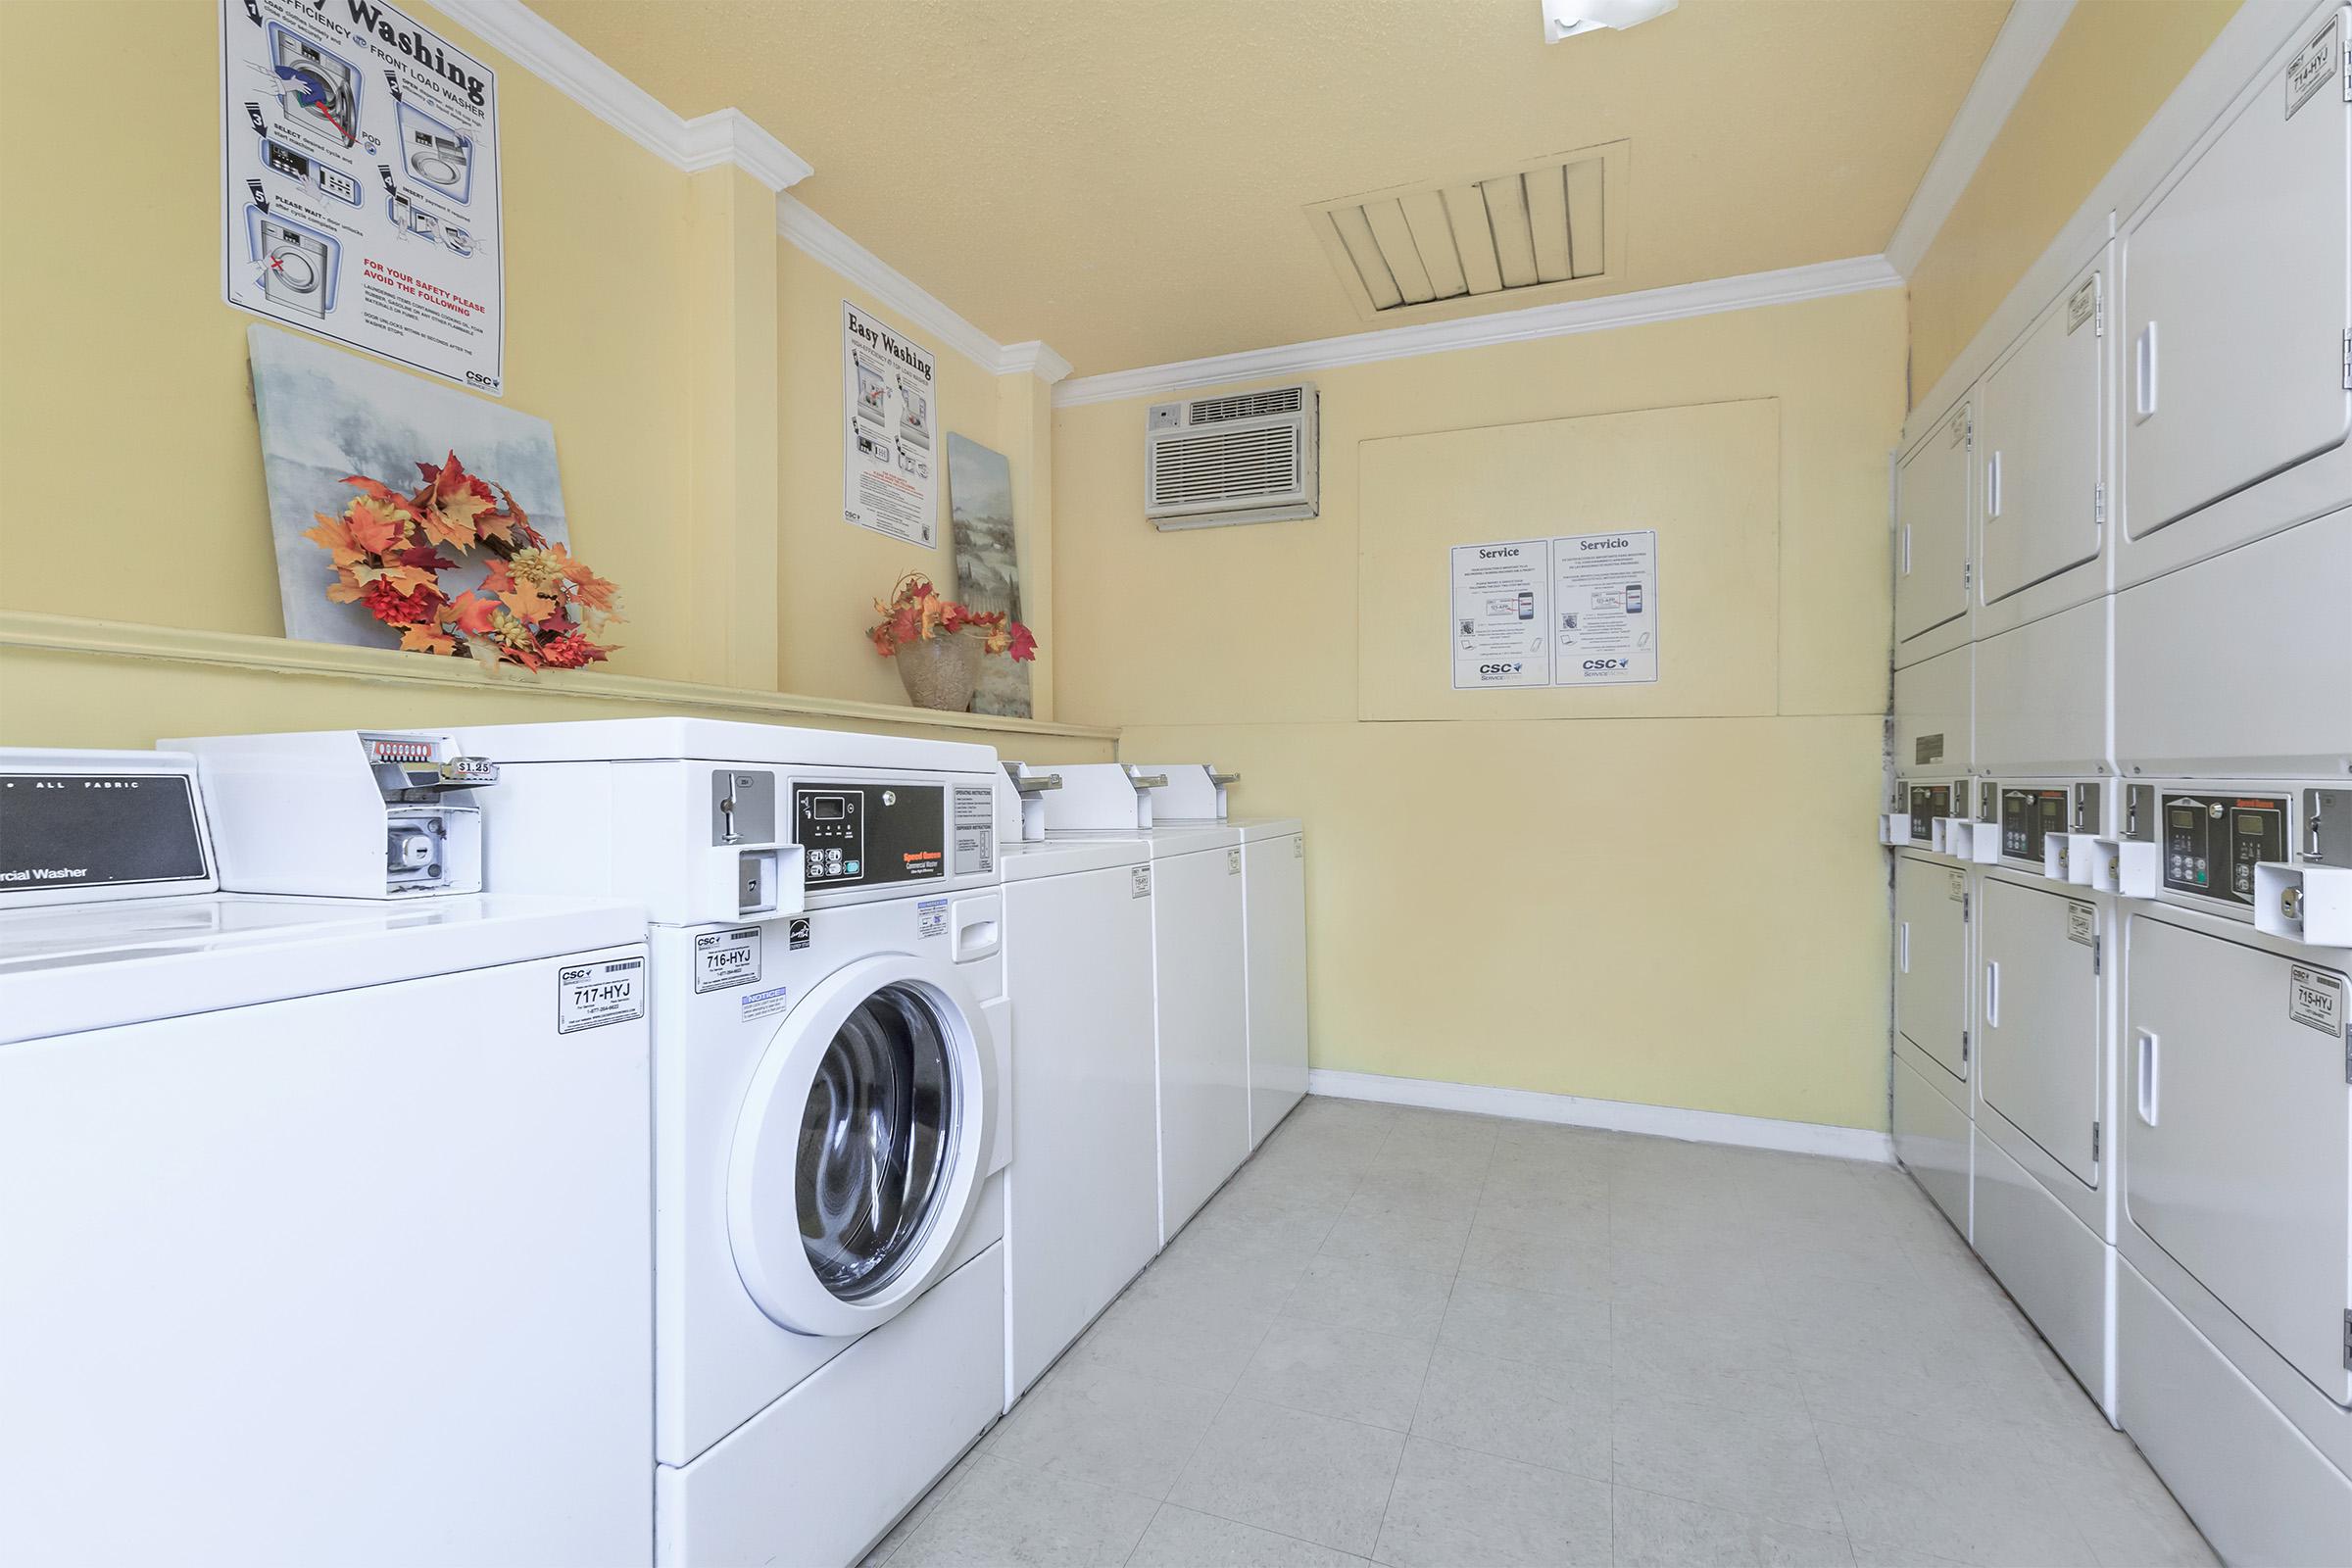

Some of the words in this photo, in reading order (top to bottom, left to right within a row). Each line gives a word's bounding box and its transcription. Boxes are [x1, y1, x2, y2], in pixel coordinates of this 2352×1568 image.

[348, 0, 485, 107] Washing
[370, 44, 408, 73] FRONT
[411, 69, 440, 92] LOAD
[442, 88, 485, 120] WASHER
[253, 114, 263, 126] 3
[274, 122, 301, 139] SELECT
[362, 131, 381, 147] POD
[255, 191, 265, 202] 5
[275, 195, 303, 212] PLEASE
[364, 258, 384, 272] FOR
[387, 267, 413, 284] YOUR
[416, 278, 451, 298] SAFETY
[453, 295, 486, 315] PLEASE
[364, 269, 394, 286] AVOID
[396, 281, 416, 296] THE
[417, 290, 470, 318] FOLLOWING
[849, 312, 879, 349] Easy
[880, 332, 932, 381] Washing
[466, 370, 492, 385] CSC
[1580, 538, 1629, 551] Servicio
[1479, 547, 1520, 560] Service
[1479, 663, 1512, 674] CSC
[1582, 659, 1618, 669] CSC
[459, 762, 490, 772] $1.25
[31, 867, 88, 880] Washer
[697, 936, 716, 947] CSC
[707, 950, 751, 968] 716-HYJ
[562, 969, 585, 981] CSC
[574, 982, 630, 1005] 717-HYJ
[748, 989, 781, 1003] NOTICE
[2298, 988, 2332, 1011] 715-HYJ
